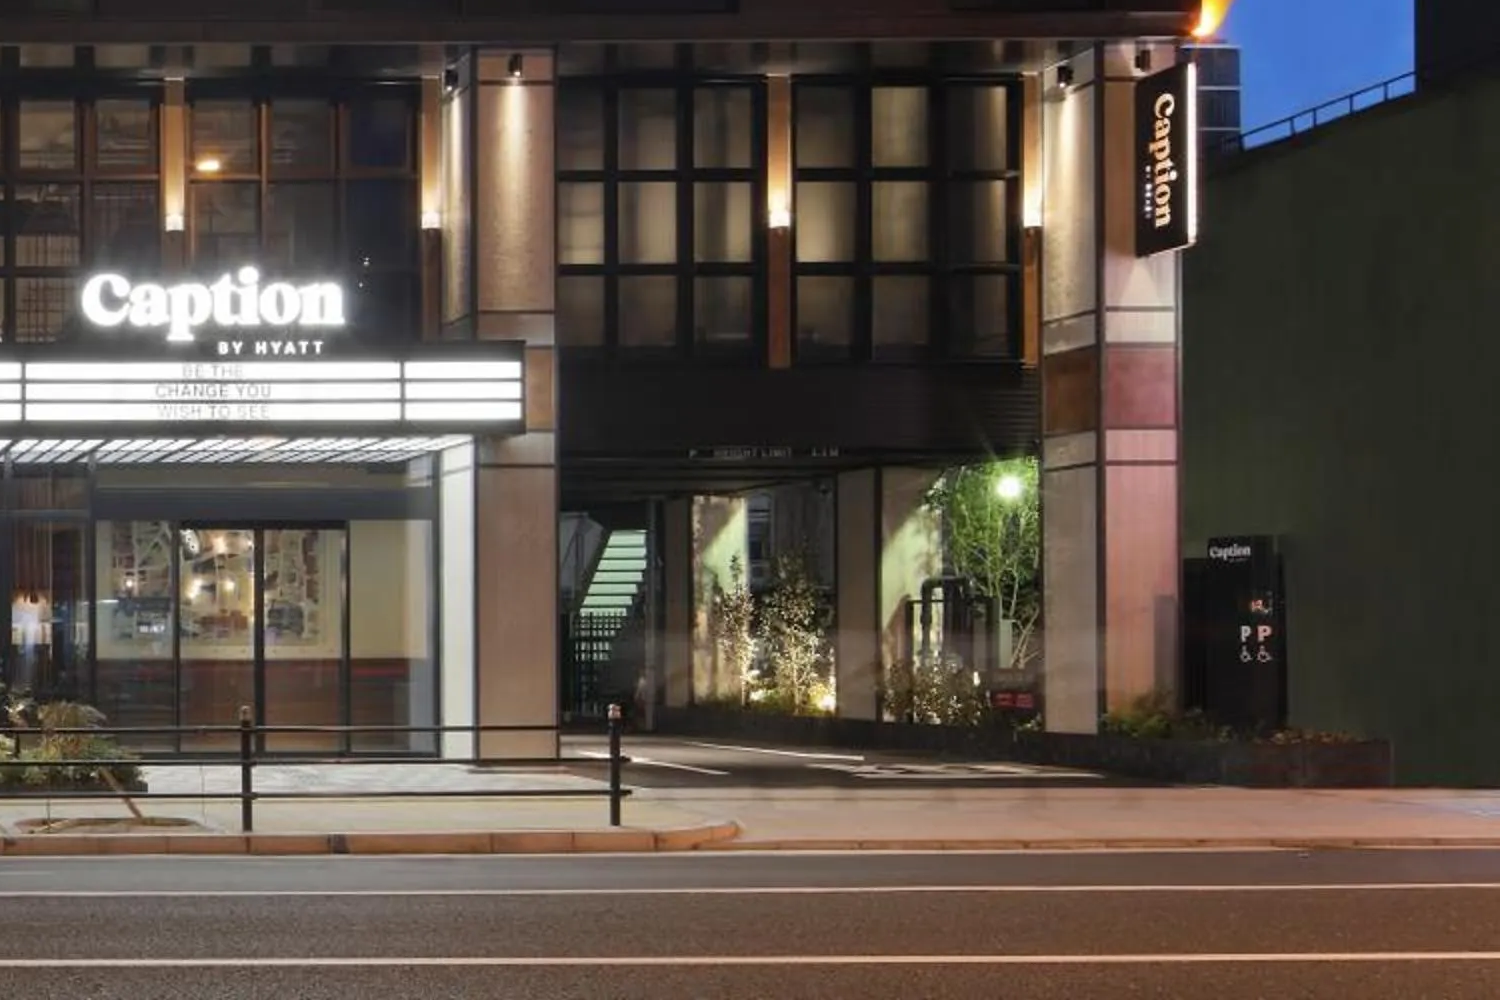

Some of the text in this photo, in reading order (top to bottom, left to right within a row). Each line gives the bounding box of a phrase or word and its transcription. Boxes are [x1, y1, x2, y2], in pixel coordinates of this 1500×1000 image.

[1149, 93, 1177, 228] Caption
[82, 266, 345, 341] Caption
[217, 341, 324, 355] BY HYATT
[182, 364, 244, 378] BE THE
[155, 384, 272, 398] CHANGE YOU
[157, 405, 271, 419] WISH TO SEE
[1240, 625, 1251, 642] P
[1257, 625, 1273, 642] P
